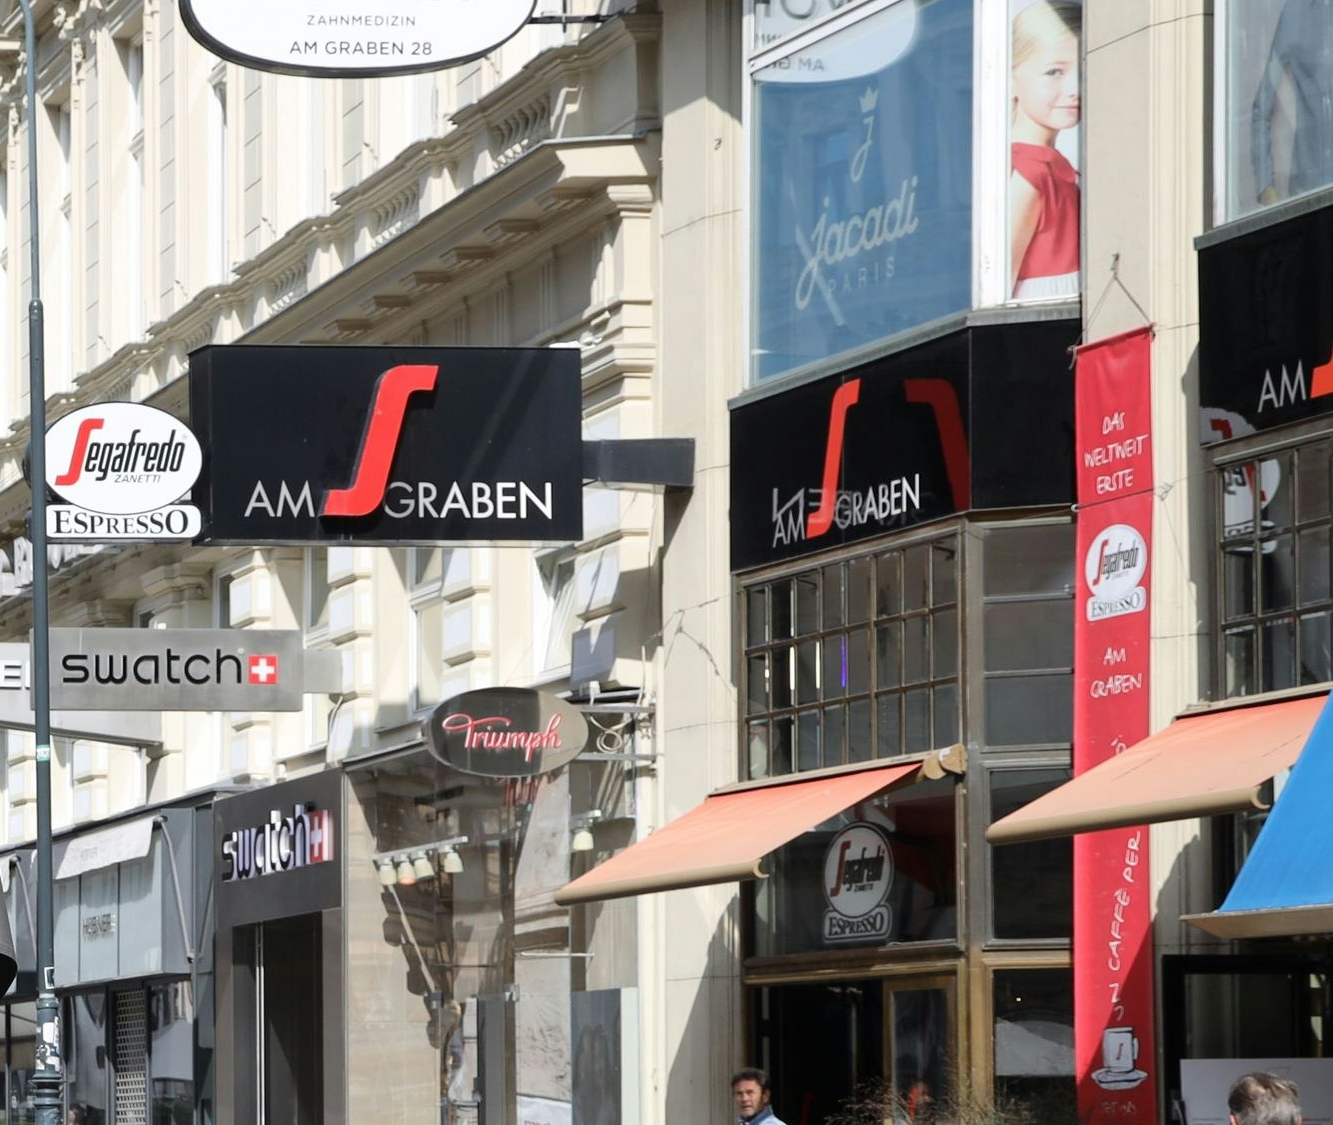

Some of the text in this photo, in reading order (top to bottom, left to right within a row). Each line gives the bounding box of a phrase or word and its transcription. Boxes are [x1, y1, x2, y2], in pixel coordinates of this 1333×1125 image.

[307, 15, 416, 26] ZAHNMEDIZIN
[289, 41, 432, 56] AM GRABEN 28
[1257, 359, 1307, 413] AM
[1102, 411, 1126, 435] DAS
[55, 418, 185, 486] Segafredo
[1084, 433, 1149, 469] WELTWEIT
[114, 474, 161, 483] ZANETTI
[1096, 468, 1134, 494] ERSTE
[244, 480, 552, 519] AM GRABEN
[835, 473, 920, 530] GRABEN
[53, 509, 189, 534] ESPRESSO
[772, 509, 806, 547] AM
[1091, 592, 1141, 619] ESPRESSO
[62, 648, 242, 684] swatch
[1103, 647, 1126, 666] AM
[1090, 672, 1143, 698] GRABEN
[442, 713, 563, 764] Triumph
[221, 804, 310, 881] swatch
[829, 911, 885, 936] ESPRESSO
